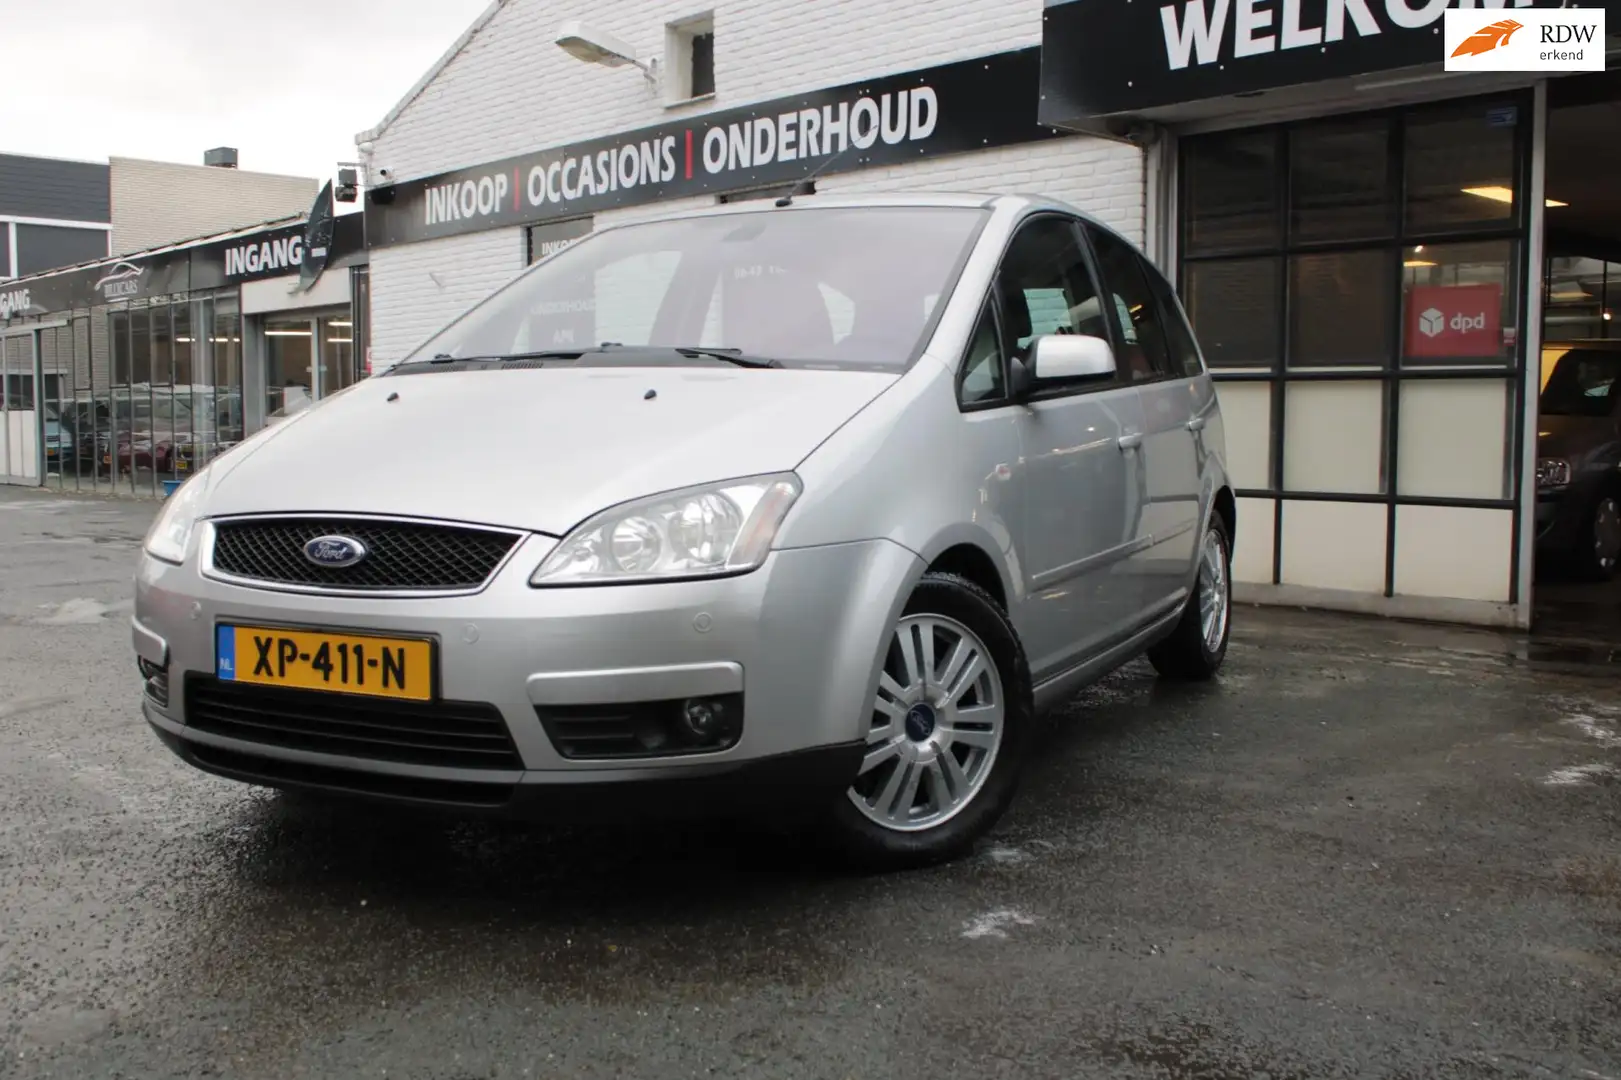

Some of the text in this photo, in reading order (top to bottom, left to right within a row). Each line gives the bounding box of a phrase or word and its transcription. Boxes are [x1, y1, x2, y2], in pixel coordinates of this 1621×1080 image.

[425, 86, 938, 225] INKOOP OCCASIONS ONDERHOUD
[225, 235, 303, 276] INGANG
[1450, 312, 1485, 334] dpd
[314, 540, 347, 560] Ford
[219, 658, 233, 671] NL
[253, 636, 405, 690] XP-411-N
